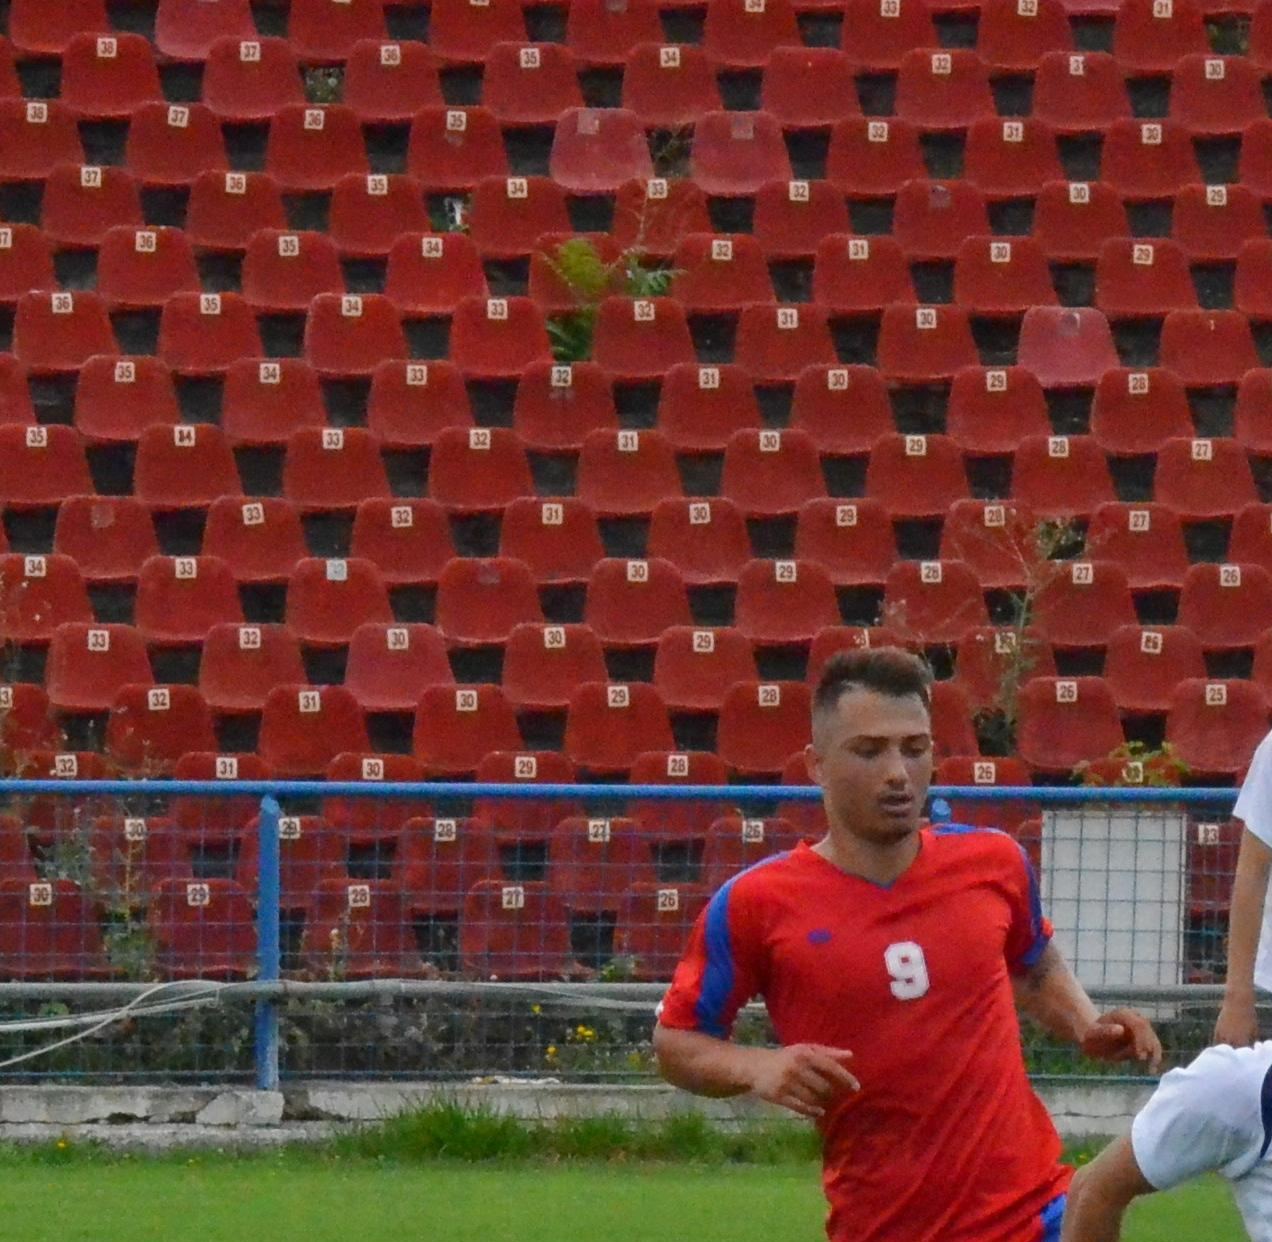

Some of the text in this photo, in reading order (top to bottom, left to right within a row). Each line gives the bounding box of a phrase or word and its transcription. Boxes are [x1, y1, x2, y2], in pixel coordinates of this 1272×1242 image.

[100, 40, 114, 56] 38
[243, 44, 258, 59] 37
[524, 50, 538, 66] 35
[663, 50, 678, 65] 34
[30, 105, 45, 121] 38
[170, 109, 187, 124] 37
[449, 114, 464, 128] 35
[84, 170, 99, 185] 37
[229, 176, 244, 191] 36
[370, 178, 385, 192] 35
[510, 181, 526, 196] 34
[793, 184, 808, 199] 32
[1073, 186, 1087, 201] 30
[1209, 189, 1225, 204] 29
[139, 234, 154, 250] 36
[282, 239, 297, 254] 35
[425, 240, 441, 255] 34
[852, 242, 865, 257] 31
[715, 243, 730, 258] 32
[1135, 247, 1151, 262] 29
[55, 296, 71, 311] 36
[204, 297, 219, 313] 35
[345, 299, 360, 314] 34
[490, 302, 505, 318] 33
[638, 302, 652, 318] 32
[780, 311, 795, 326] 31
[118, 365, 133, 380] 35
[263, 365, 278, 381] 34
[410, 367, 425, 383] 33
[555, 369, 569, 384] 32
[702, 371, 716, 386] 31
[832, 372, 846, 388] 30
[989, 374, 1005, 389] 29
[30, 428, 45, 444] 35
[326, 432, 341, 448] 33
[473, 431, 488, 447] 32
[621, 434, 635, 450] 31
[762, 434, 778, 449] 30
[908, 438, 924, 454] 29
[1051, 439, 1067, 455] 28
[1195, 442, 1209, 458] 27
[246, 506, 262, 523] 33
[395, 509, 410, 525] 32
[545, 506, 559, 523] 31
[693, 506, 708, 522] 30
[839, 508, 855, 523] 29
[1132, 513, 1147, 529] 27
[28, 559, 44, 575] 34
[179, 561, 194, 576] 33
[631, 564, 646, 580] 30
[778, 564, 794, 580] 29
[1075, 566, 1090, 582] 27
[1223, 568, 1239, 585] 26
[91, 632, 106, 649] 33
[243, 630, 259, 646] 32
[547, 629, 563, 646] 30
[696, 634, 712, 650] 29
[152, 692, 168, 708] 32
[611, 689, 626, 705] 29
[762, 688, 778, 704] 28
[1059, 684, 1075, 700] 26
[1209, 687, 1224, 703] 25
[302, 694, 317, 711] 31
[460, 693, 475, 708] 30
[518, 759, 534, 775] 29
[670, 757, 686, 774] 28
[33, 886, 51, 903] 30
[351, 888, 368, 904] 28
[659, 892, 676, 908] 26
[883, 941, 930, 1001] 9
